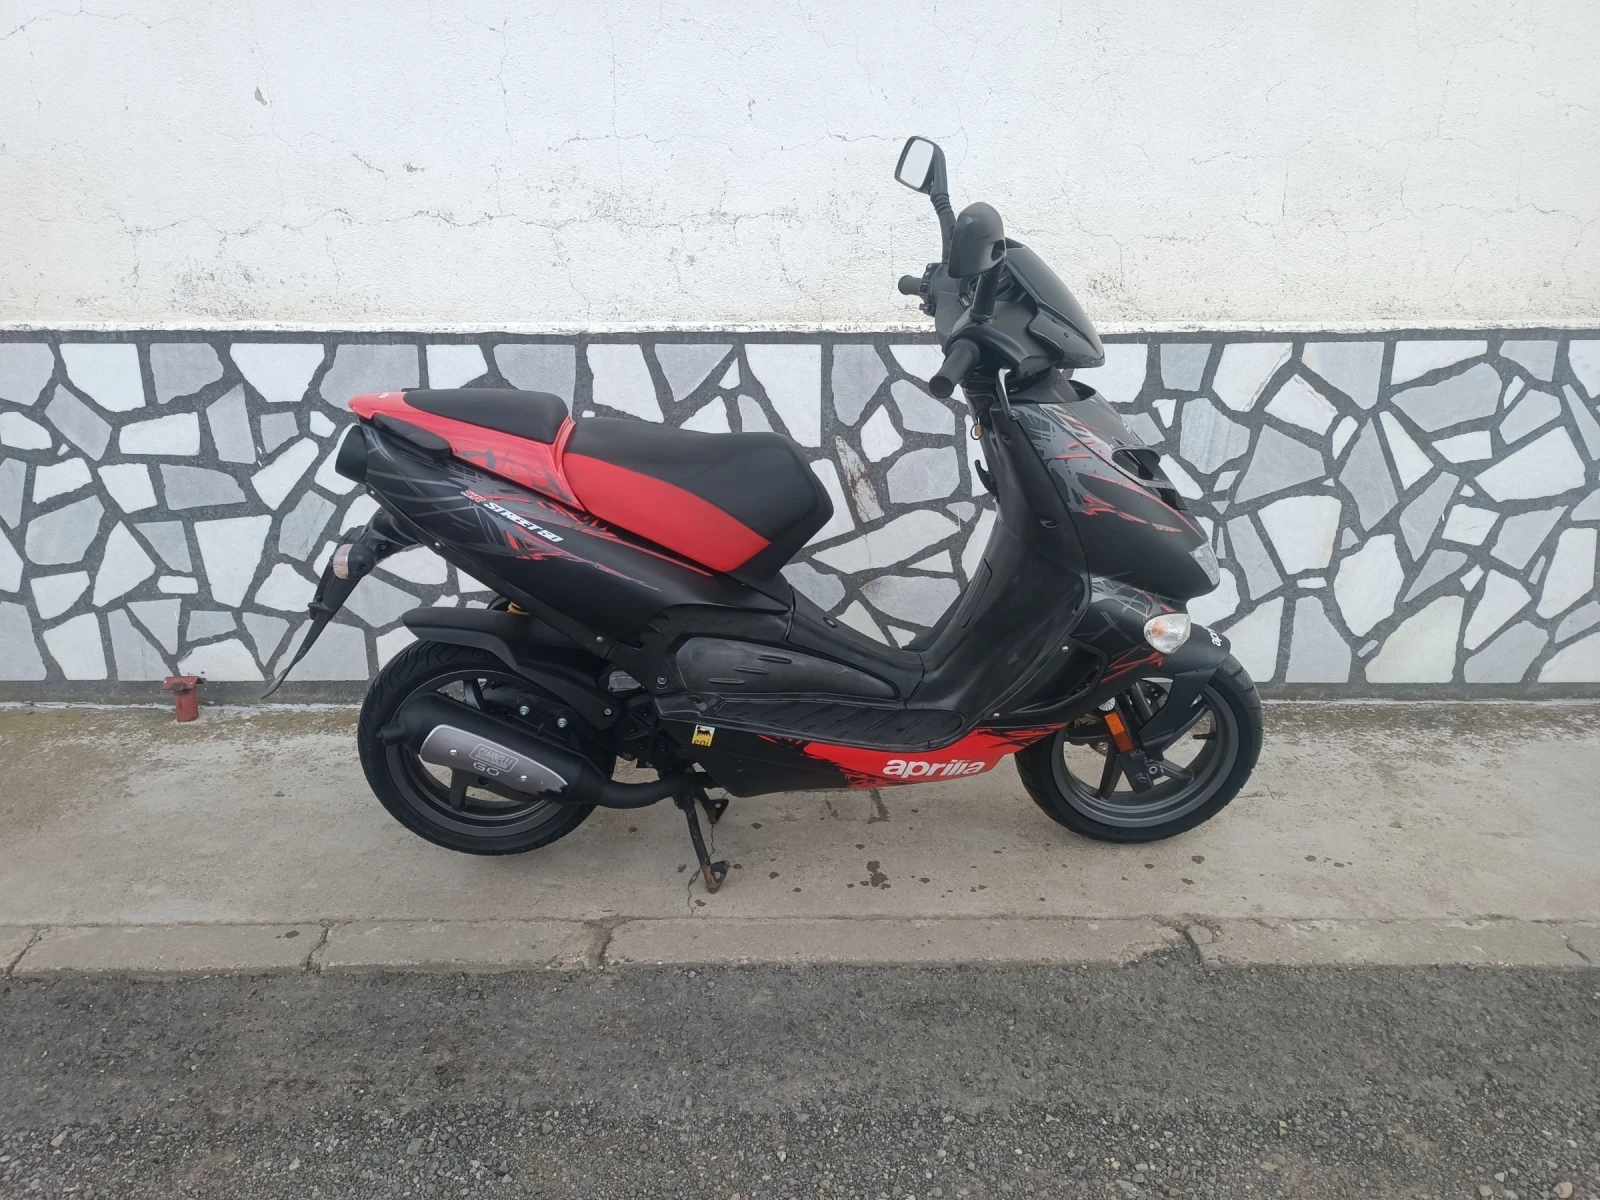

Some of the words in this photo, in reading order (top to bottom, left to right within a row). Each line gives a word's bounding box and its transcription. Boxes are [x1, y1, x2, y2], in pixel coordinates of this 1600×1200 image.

[483, 502, 543, 531] STREET
[537, 529, 564, 543] 50
[477, 747, 514, 766] GIANNELLI
[882, 759, 986, 779] aprilia
